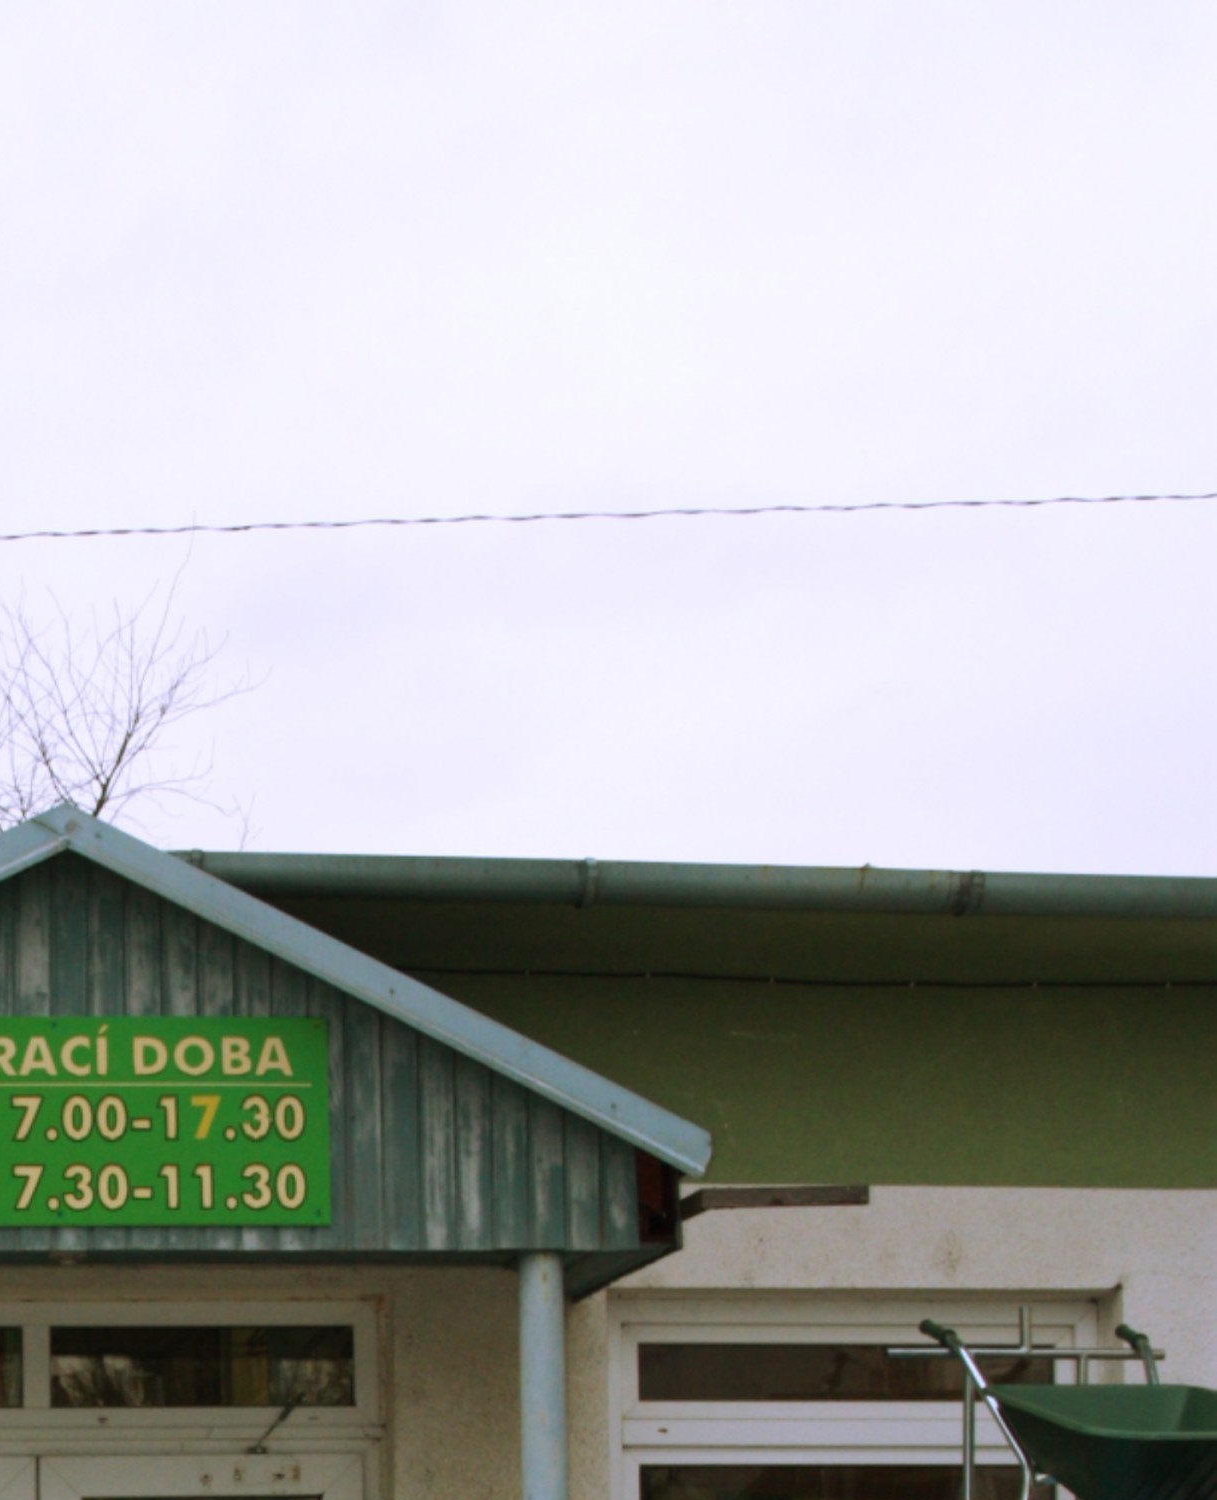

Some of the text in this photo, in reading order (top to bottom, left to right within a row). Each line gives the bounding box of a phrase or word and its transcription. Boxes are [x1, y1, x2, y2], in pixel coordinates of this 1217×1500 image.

[133, 1036, 294, 1076] DOBA
[10, 1095, 306, 1142] 7.00-17.30
[12, 1163, 306, 1211] 7.30-11.30
